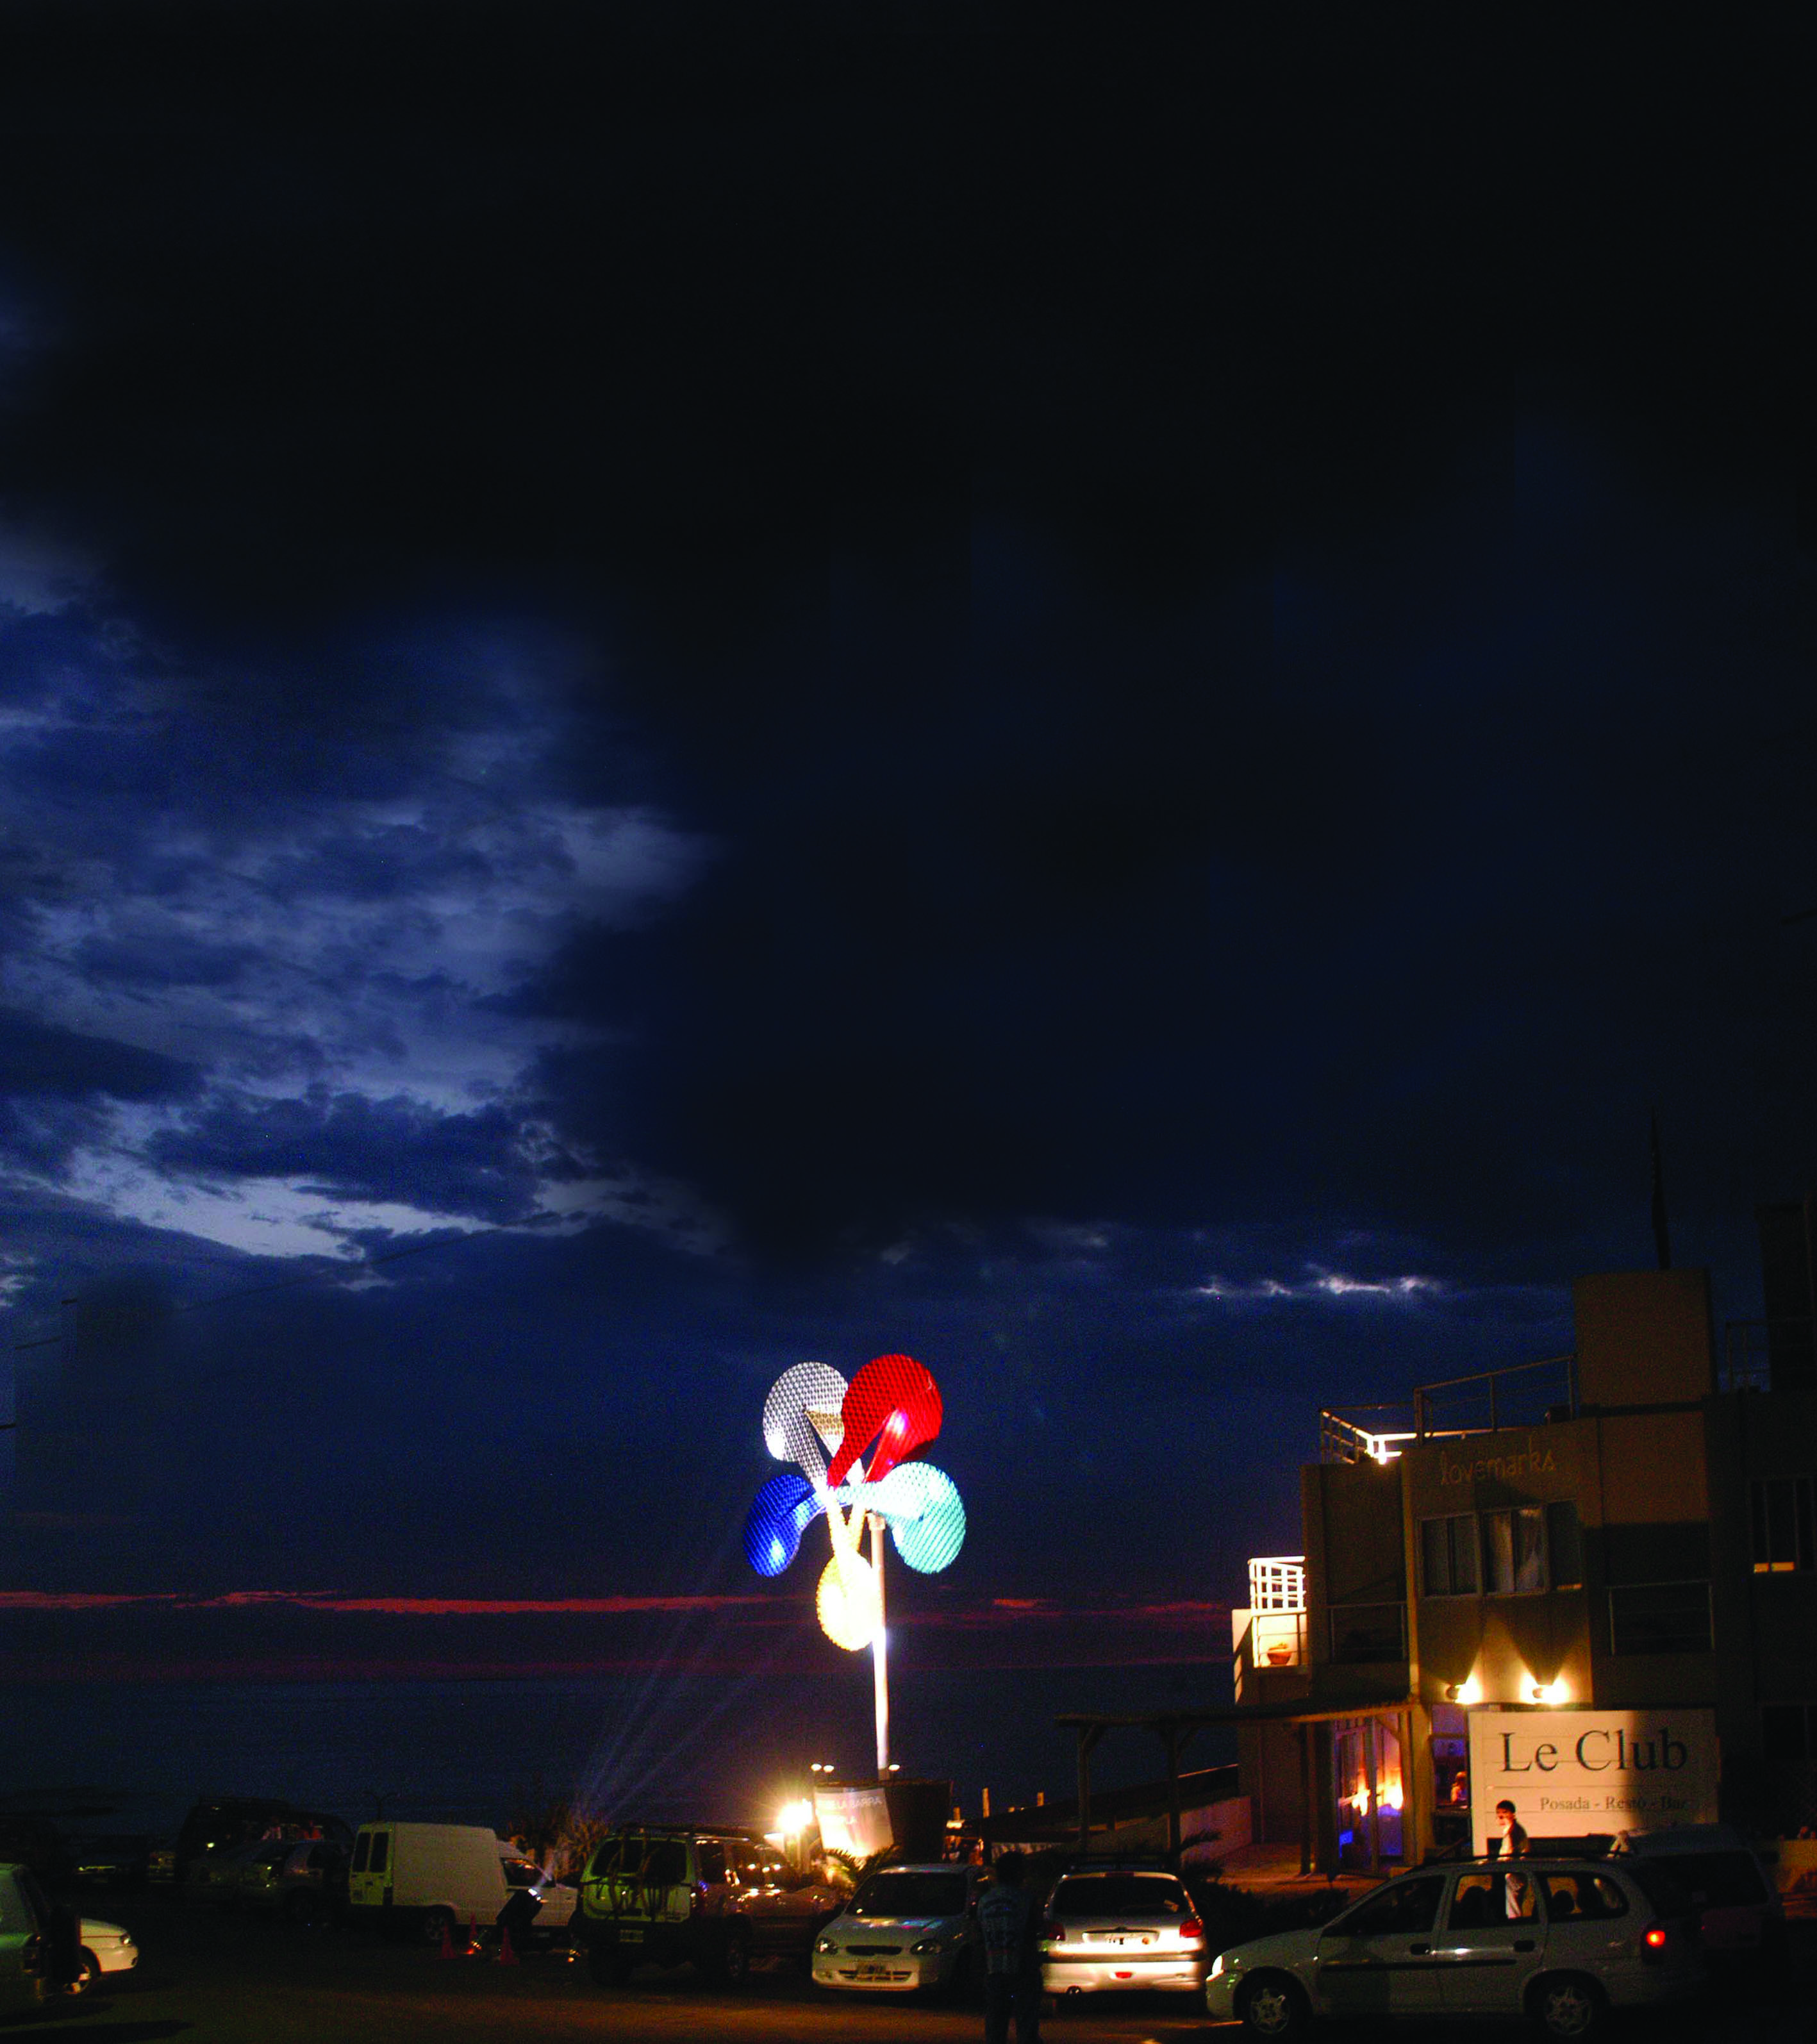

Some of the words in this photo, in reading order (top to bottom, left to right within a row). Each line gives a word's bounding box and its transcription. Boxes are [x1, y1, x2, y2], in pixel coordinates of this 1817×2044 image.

[1498, 1732, 1558, 1772] Le
[1575, 1729, 1688, 1771] Club
[1540, 1796, 1590, 1810] Posada
[1661, 1795, 1686, 1809] Bar
